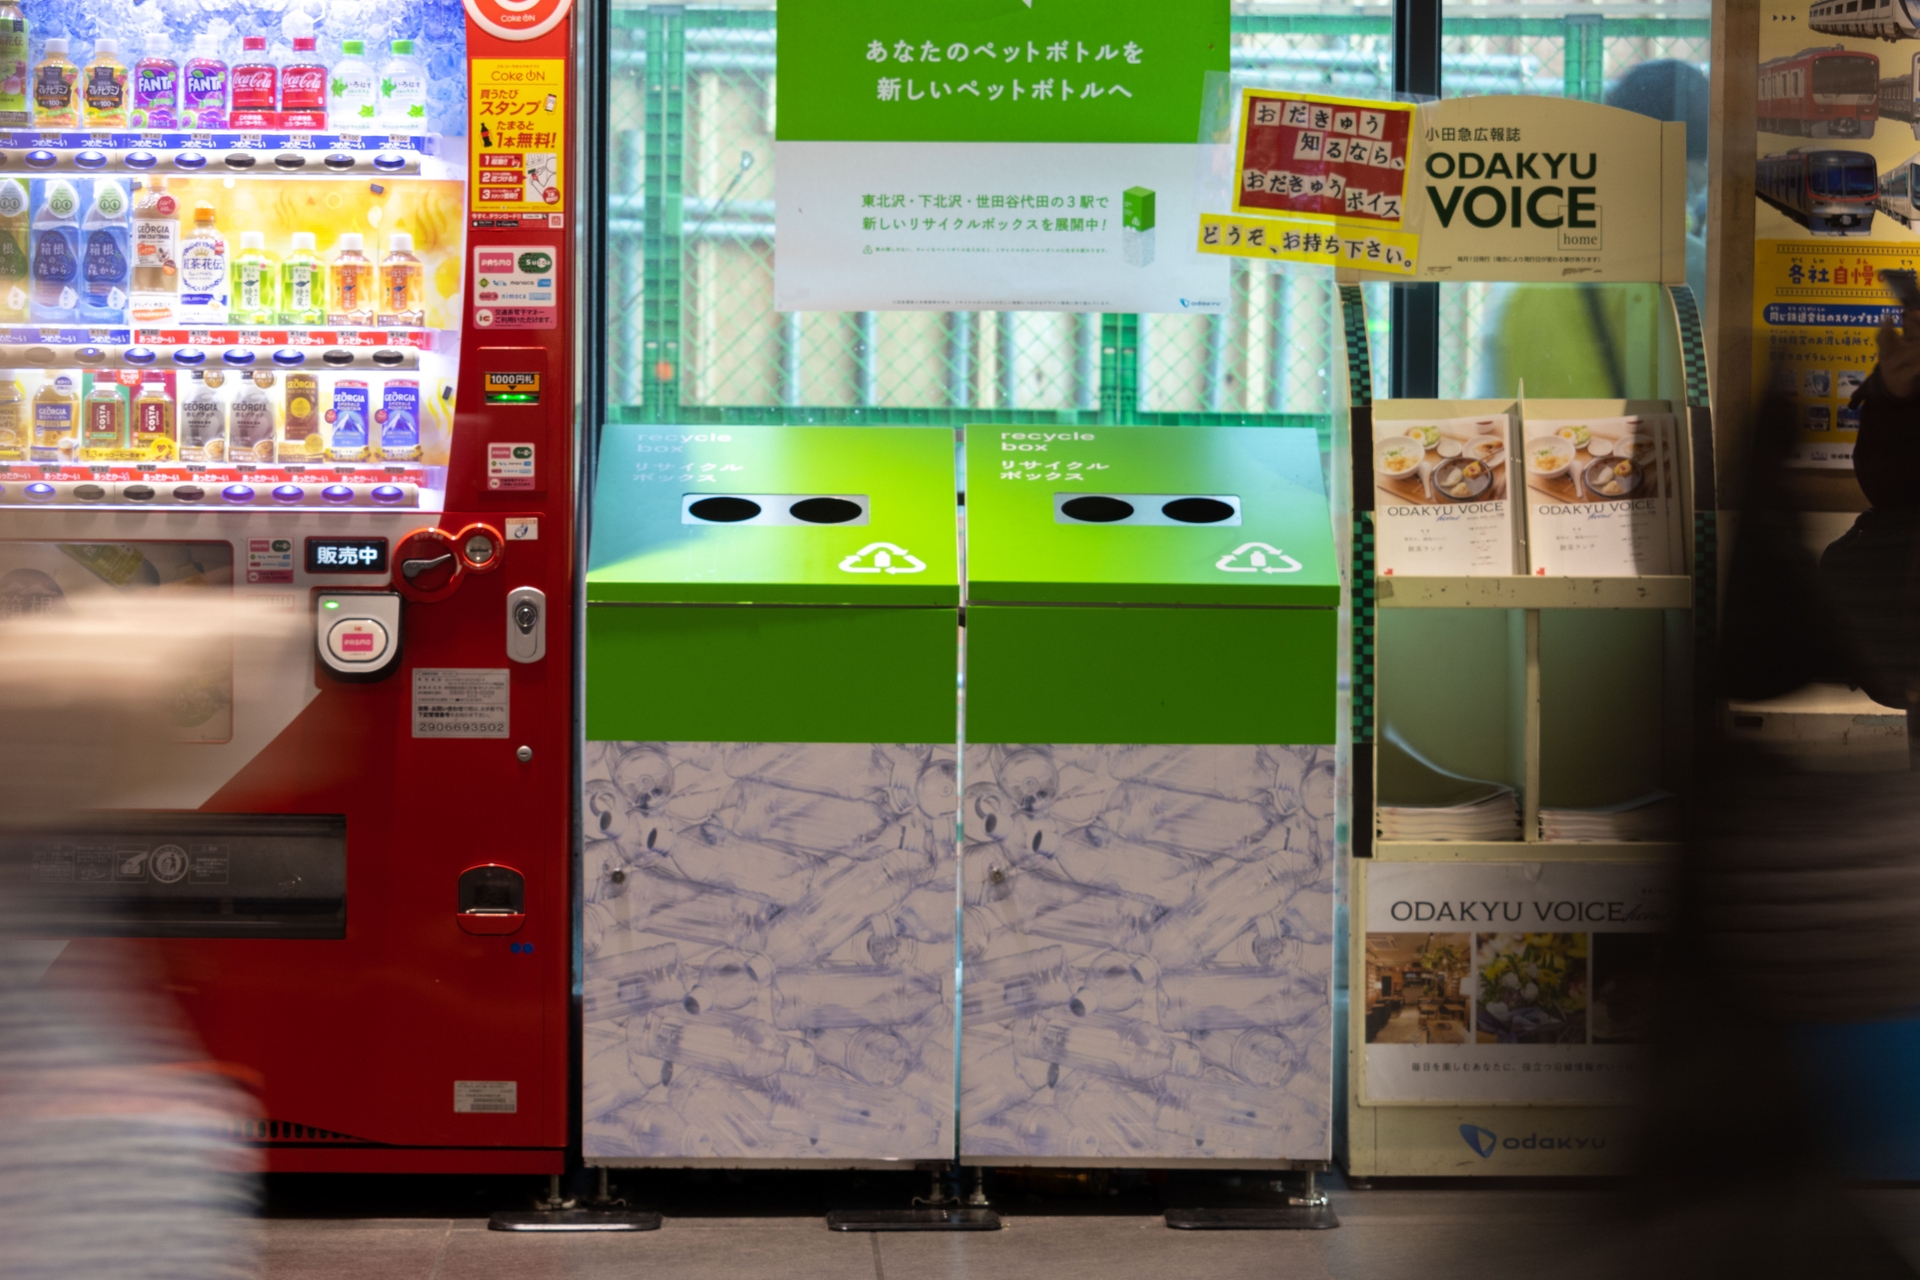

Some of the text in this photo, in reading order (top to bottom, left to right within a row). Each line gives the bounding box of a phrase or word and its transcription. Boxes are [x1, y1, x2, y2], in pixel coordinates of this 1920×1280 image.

[500, 14, 522, 22] Coke
[866, 40, 1144, 64] あなたのペットボトルを
[233, 72, 273, 88] Coca-Cola
[283, 72, 322, 89] Coca-Cola
[491, 69, 545, 81] Coke ON
[138, 76, 172, 92] FANTA
[188, 77, 222, 92] FANTA
[876, 77, 1133, 102] 新しいペットボトルへ
[480, 89, 519, 100] 買うたび
[480, 100, 542, 116] スタンプ
[1256, 104, 1380, 134] おだきゅう
[497, 121, 534, 130] たまると
[497, 132, 557, 148] 1本無料!
[1425, 127, 1521, 142] 小田急広報誌
[1300, 132, 1404, 168] 知るなら、
[1425, 152, 1596, 180] ODAKYU
[482, 172, 491, 183] 2
[482, 189, 491, 200] 3
[1425, 186, 1596, 228] VOICE
[138, 223, 170, 233] GEORGIA
[862, 217, 1107, 232] 新しいリサイクルボックスを展開中!
[1563, 233, 1598, 246] home
[40, 243, 65, 255] 箱根
[90, 243, 115, 255] 箱根
[1202, 226, 1412, 268] どうぞ、お持ち下さい。
[38, 264, 66, 275] 森から
[88, 264, 116, 276] 森から
[183, 258, 223, 270] 紅茶花伝
[491, 375, 534, 384] 1000円札
[334, 394, 365, 402] GEORGIA
[384, 393, 416, 402] GEORGIA
[183, 403, 218, 412] GEORGIA
[232, 403, 267, 412] GEORGIA
[638, 432, 732, 443] recycle
[1001, 431, 1095, 442] recycle
[637, 444, 684, 453] box
[1001, 442, 1048, 451] box
[636, 462, 744, 472] リサイクル
[1002, 460, 1109, 470] リサイクル
[633, 473, 716, 482] ボックス
[1000, 471, 1084, 481] ボックス
[1387, 502, 1504, 517] ODAKYU VOICE
[1539, 500, 1656, 516] ODAKYU VOICE
[317, 546, 378, 565] 販売中
[420, 723, 504, 732] 2906693502
[1391, 901, 1523, 921] ODAKYU
[1533, 901, 1624, 922] VOICE
[1503, 1133, 1606, 1150] odakyu
